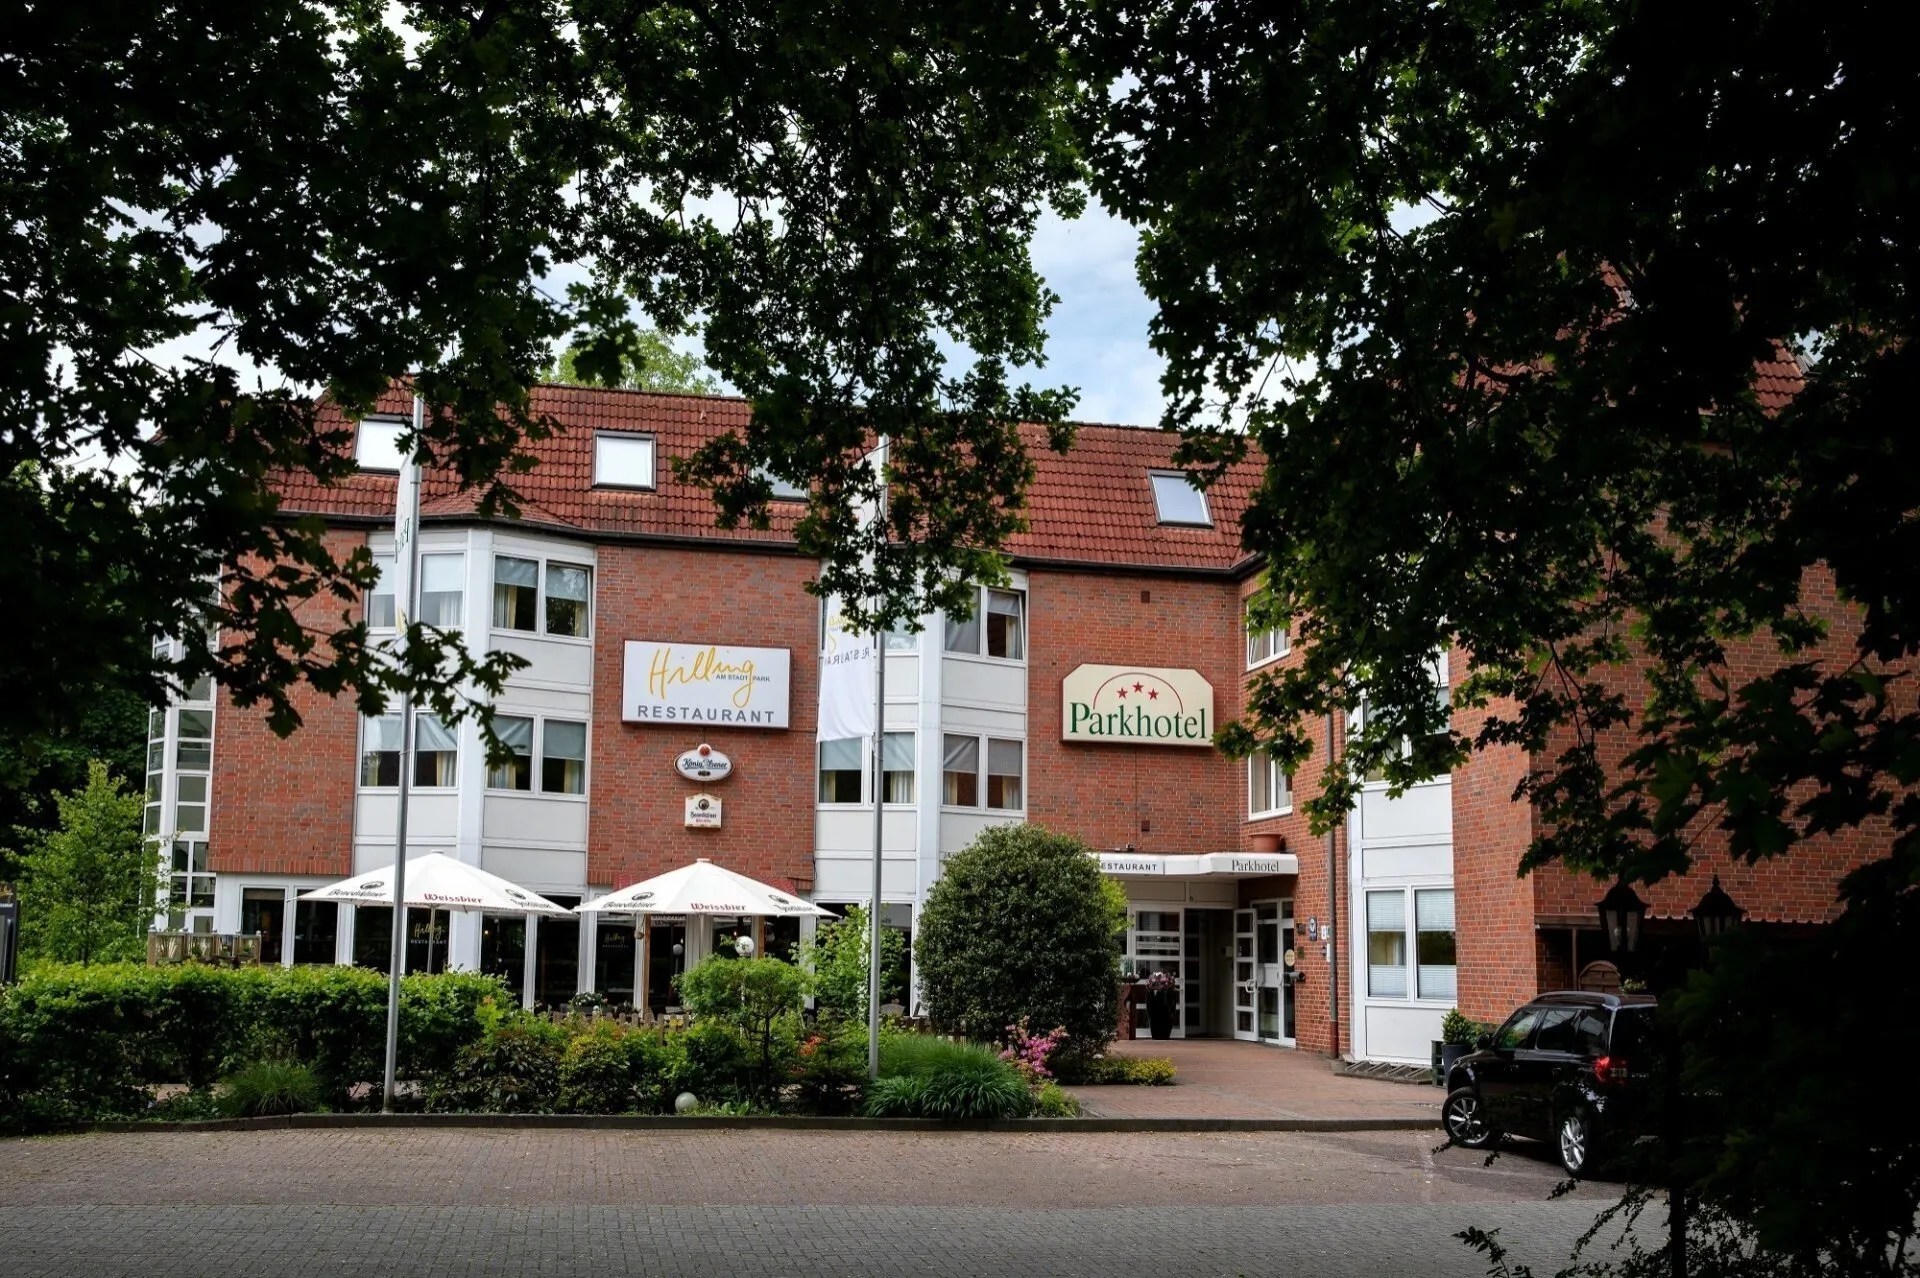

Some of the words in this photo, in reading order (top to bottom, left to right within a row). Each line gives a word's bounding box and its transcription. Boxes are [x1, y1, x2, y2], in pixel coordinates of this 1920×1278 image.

[650, 646, 755, 708] Hilling
[637, 704, 775, 724] RESTAURANT
[1069, 702, 1207, 740] Parkhotel
[1101, 862, 1157, 871] ESTAURANT
[1232, 859, 1280, 873] Parkhotel
[424, 893, 483, 904] Weissbier
[690, 902, 746, 911] Weissbier
